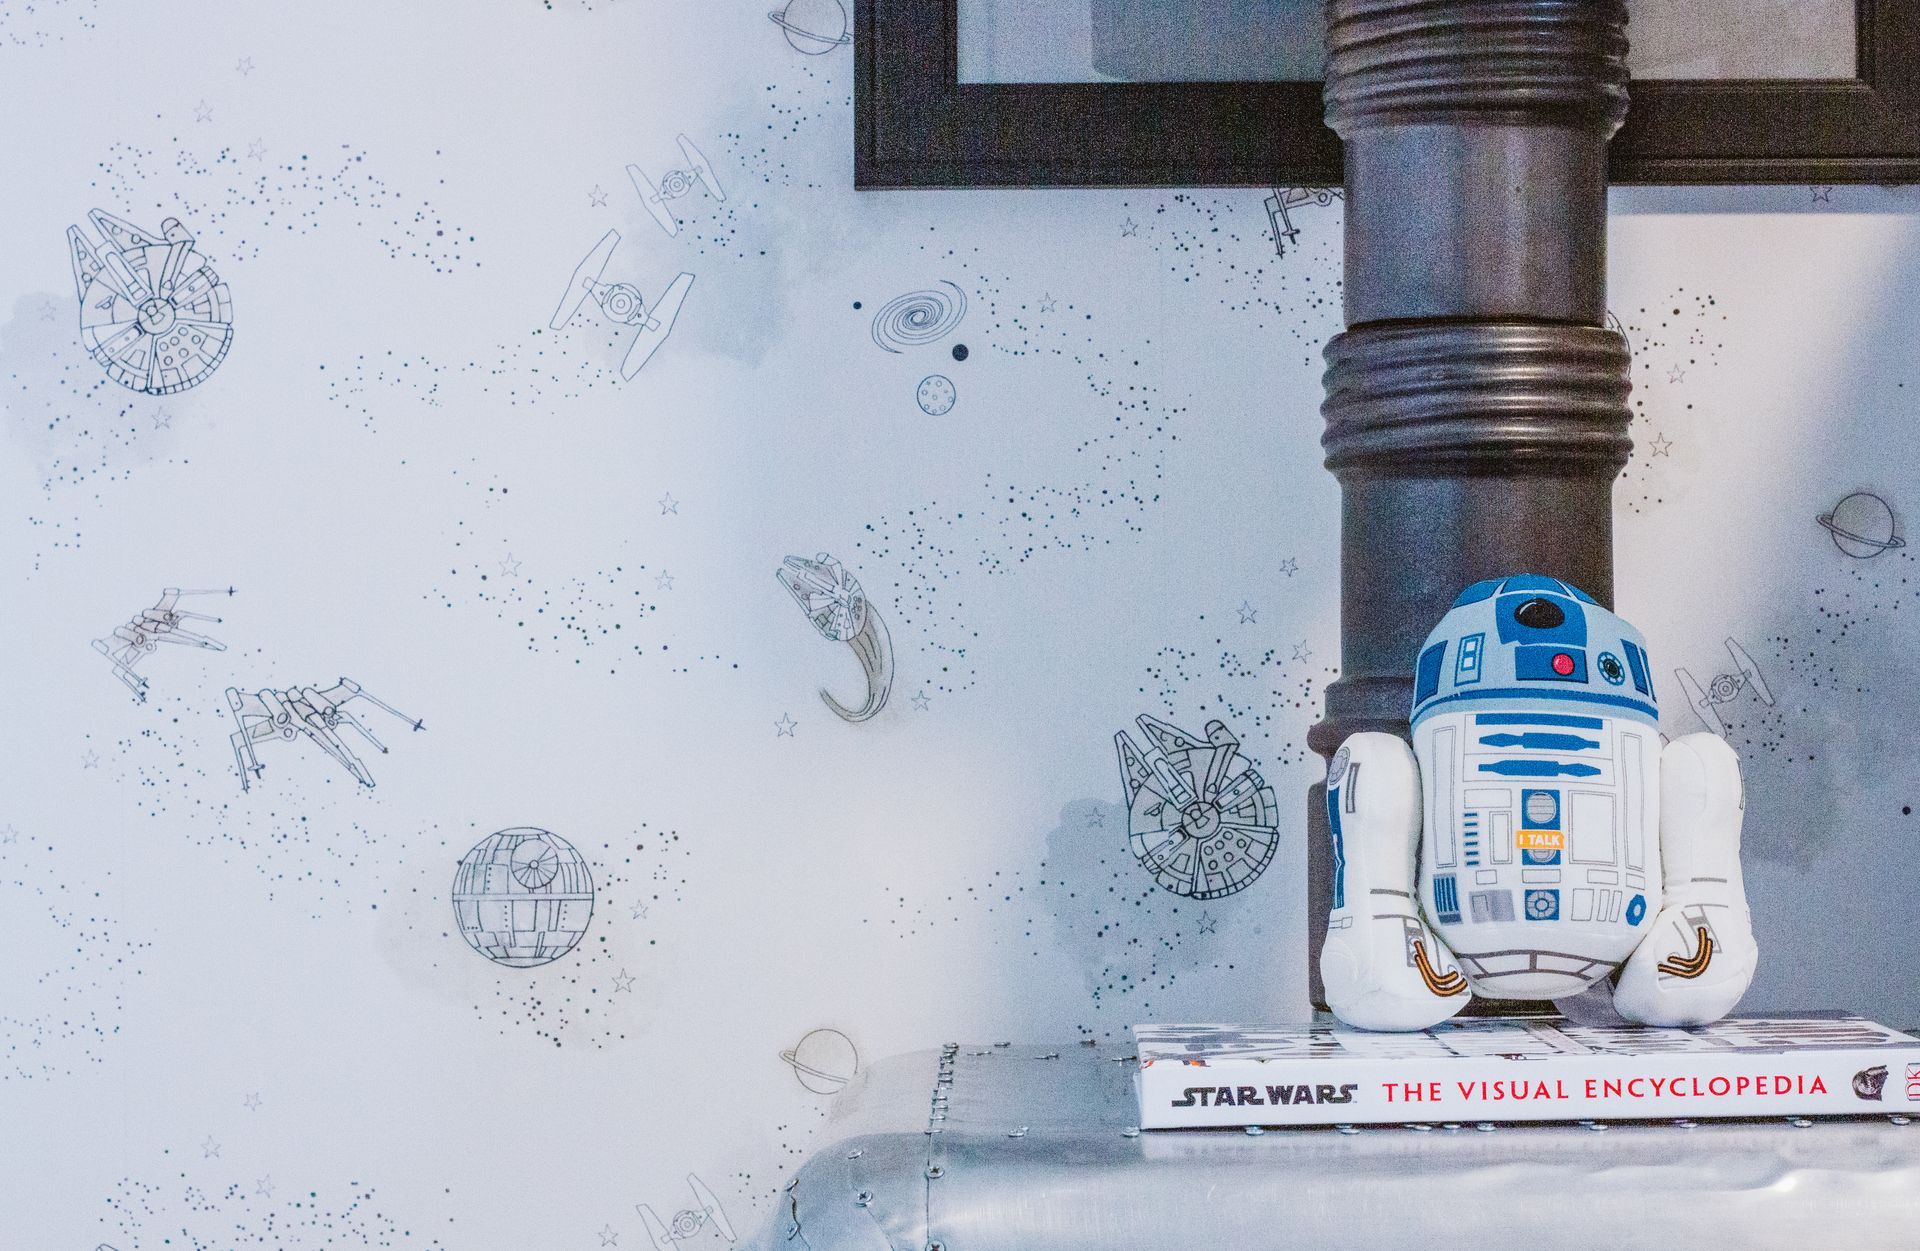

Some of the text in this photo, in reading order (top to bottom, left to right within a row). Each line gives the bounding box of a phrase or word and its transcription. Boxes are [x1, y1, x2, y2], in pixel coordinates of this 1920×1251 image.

[1519, 834, 1560, 846] I TALK
[1171, 1075, 1827, 1107] STAR WARS THE VISUAL ENCYCLOPEDIA
[1907, 1067, 1920, 1097] DK
